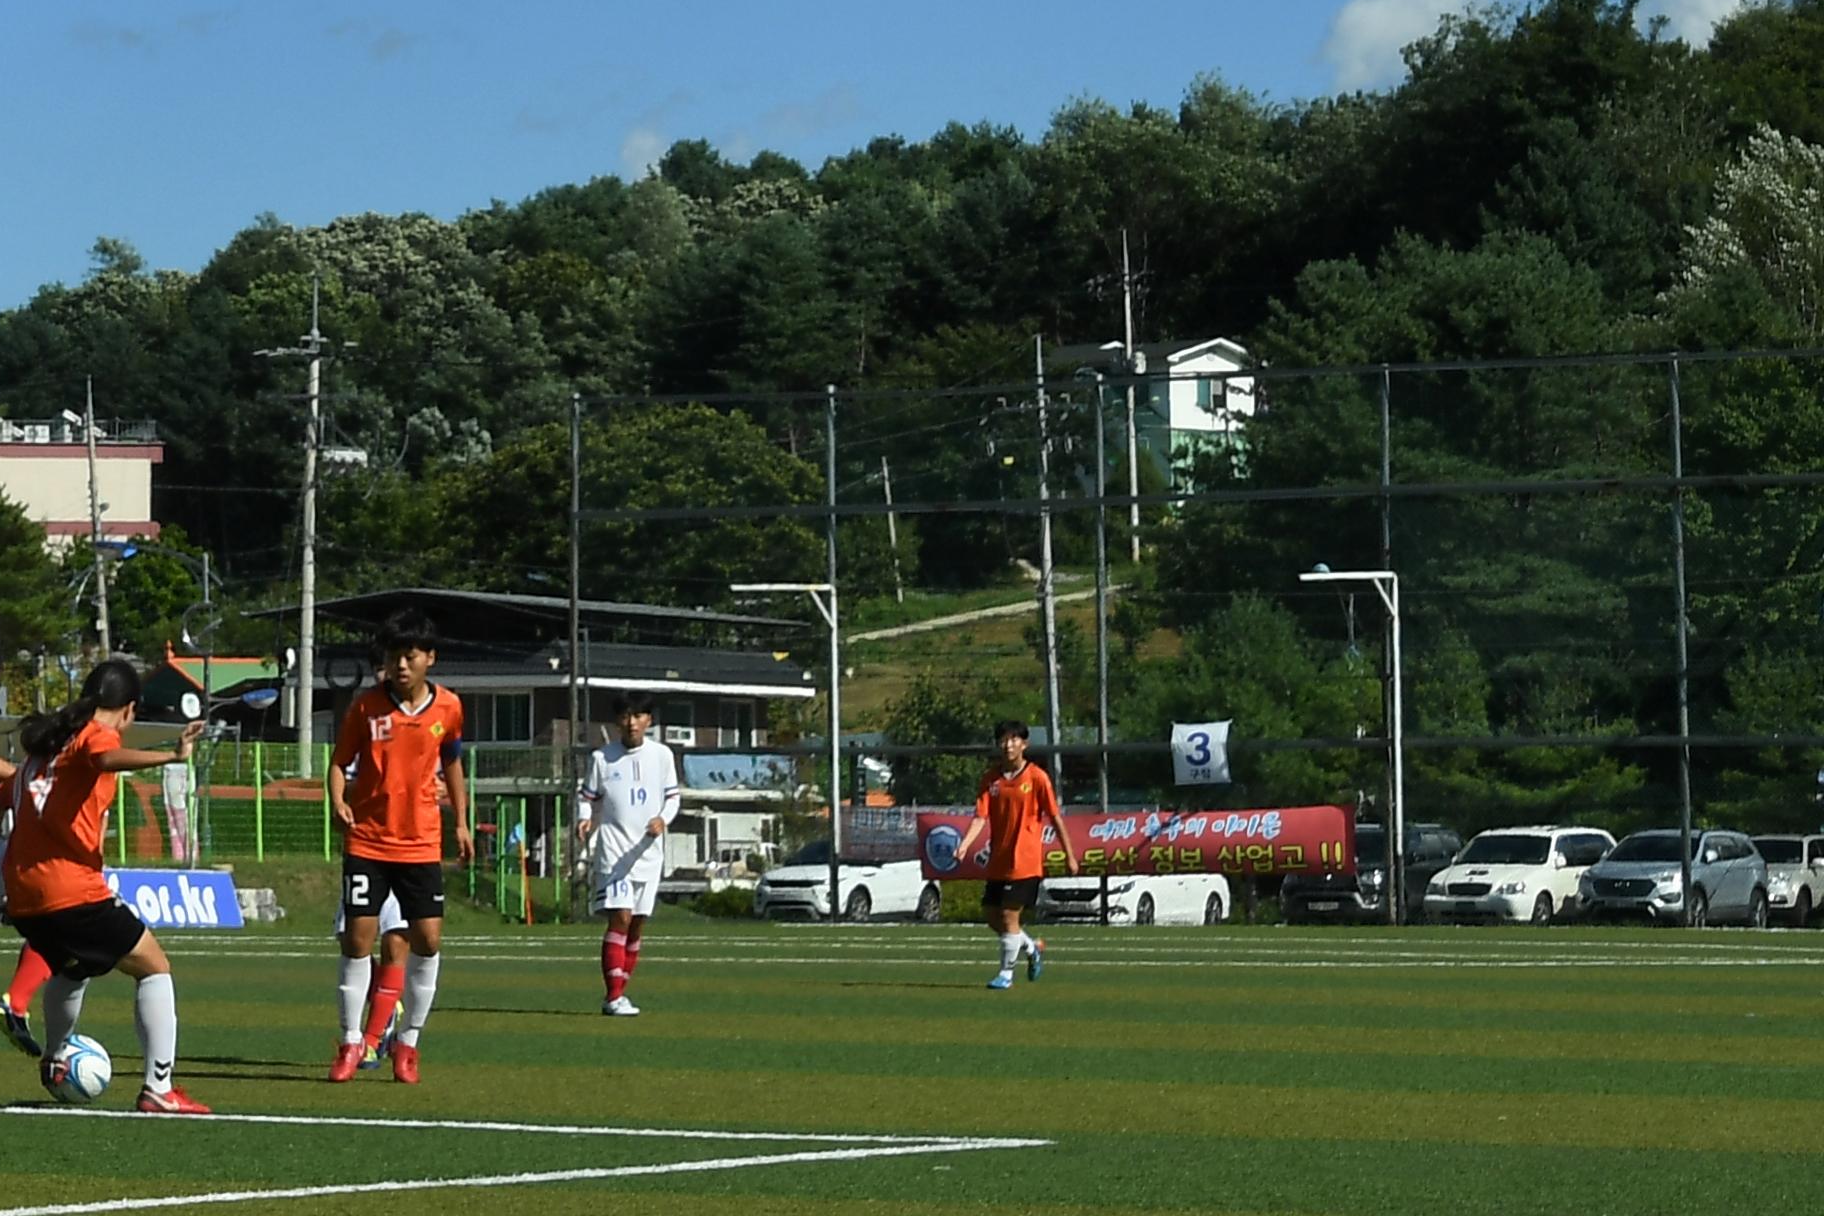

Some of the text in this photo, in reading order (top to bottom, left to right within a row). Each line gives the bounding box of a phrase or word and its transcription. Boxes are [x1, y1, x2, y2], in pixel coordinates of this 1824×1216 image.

[369, 716, 392, 741] 12
[1185, 731, 1211, 767] 3
[630, 787, 647, 806] 19
[1149, 845, 1206, 874] 정보
[1217, 844, 1308, 873] 산업고
[1320, 841, 1343, 870] !!
[345, 874, 370, 906] 12
[611, 880, 629, 898] 19
